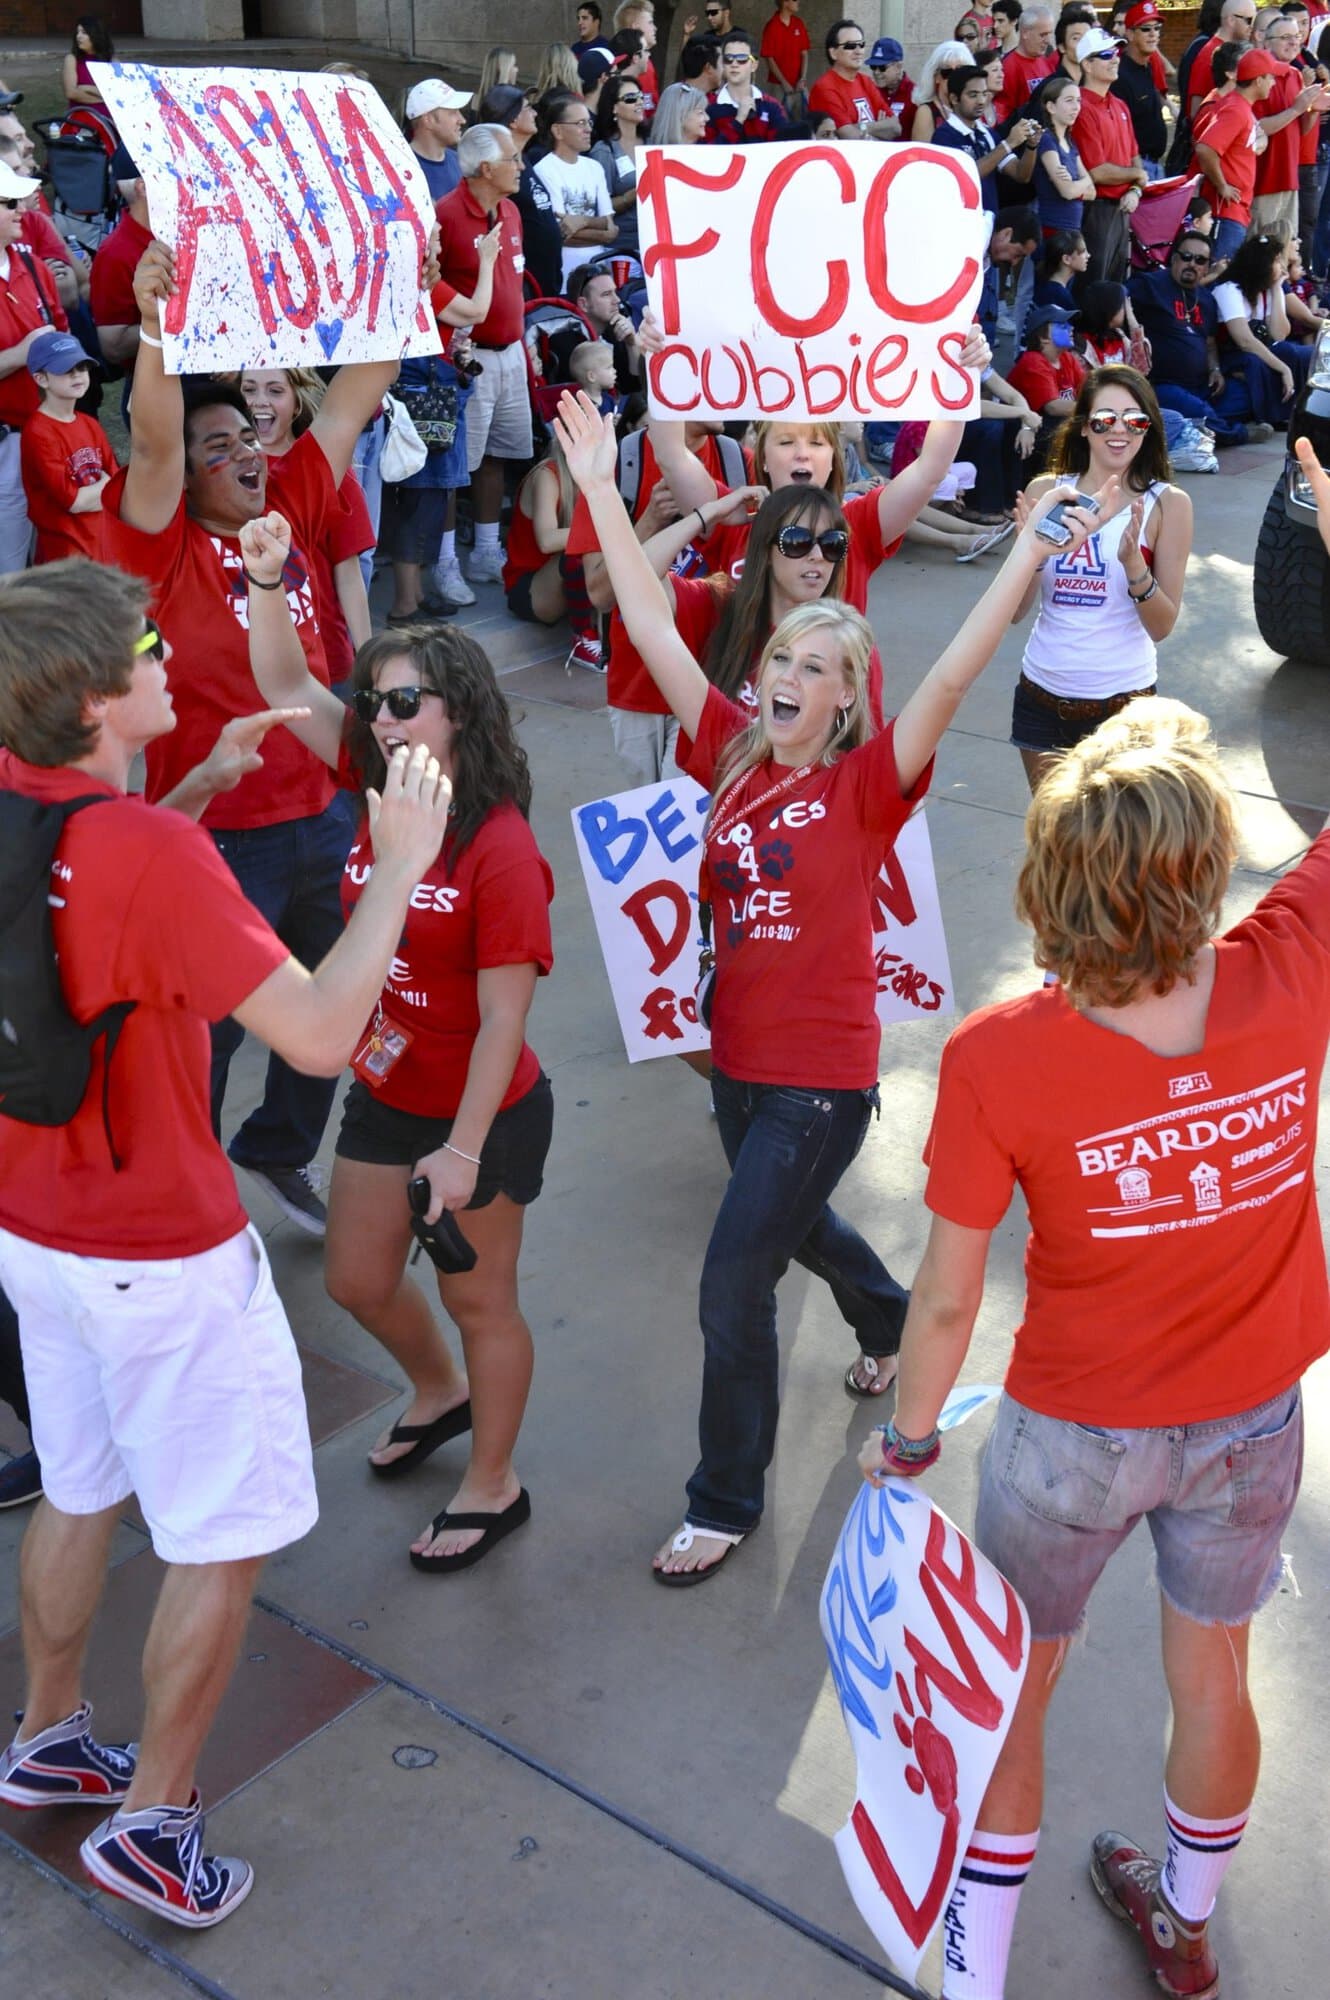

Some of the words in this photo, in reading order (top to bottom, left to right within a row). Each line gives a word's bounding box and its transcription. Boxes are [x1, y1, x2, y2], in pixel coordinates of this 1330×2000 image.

[637, 146, 980, 339] FCC
[650, 332, 975, 415] cubbies
[1055, 533, 1106, 577] A
[1054, 578, 1107, 593] ARIZONA
[738, 845, 760, 883] 4
[729, 888, 792, 924] LIFE
[1231, 1120, 1302, 1170] SUPERCUTS
[1194, 1178, 1221, 1201] 125
